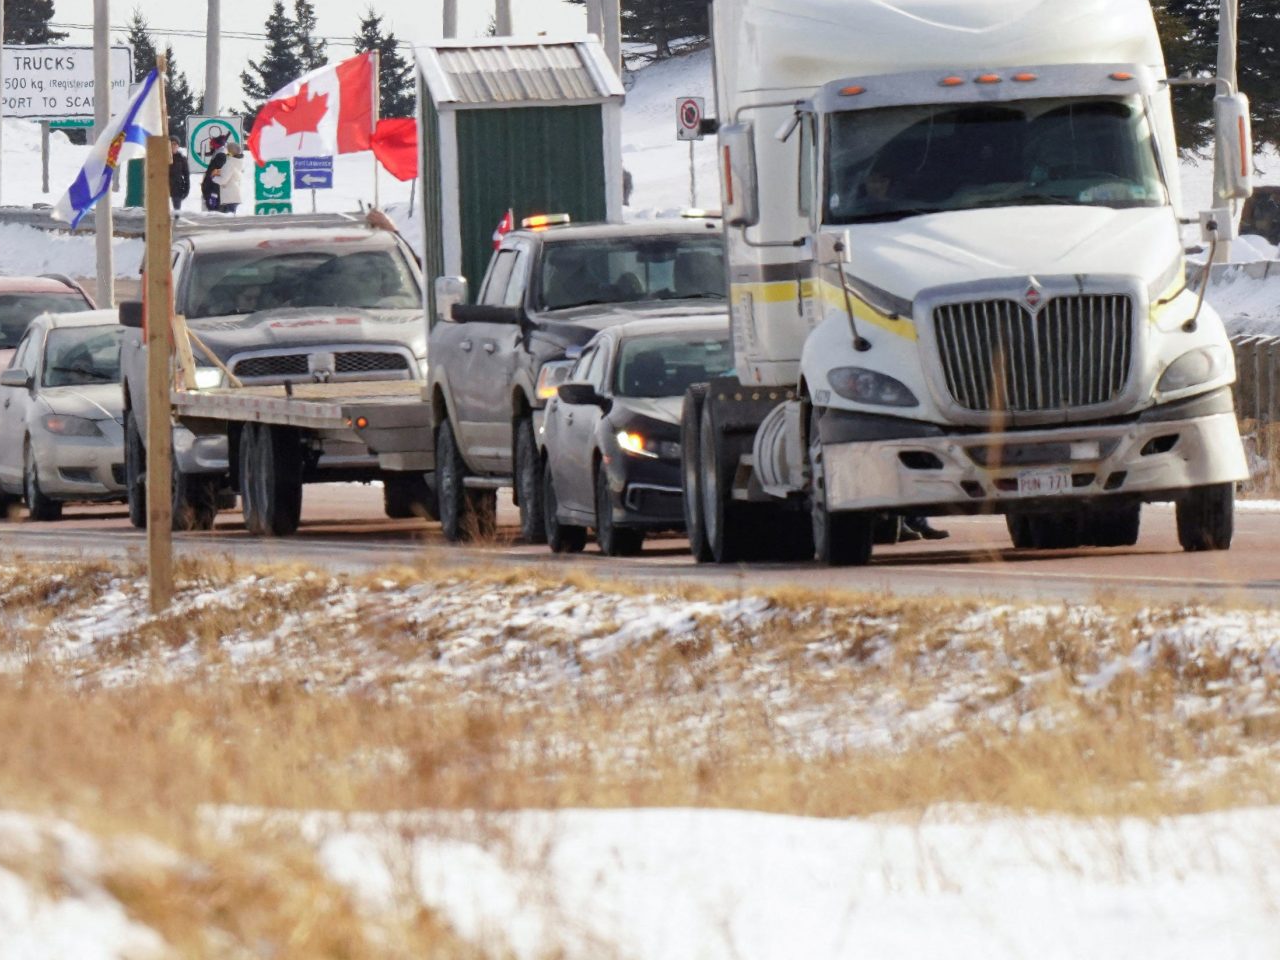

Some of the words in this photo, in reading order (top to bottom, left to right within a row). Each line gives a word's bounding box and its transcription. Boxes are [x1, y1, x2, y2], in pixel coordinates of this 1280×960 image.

[13, 56, 75, 71] TRUCKS
[31, 78, 44, 93] kg
[43, 96, 57, 109] TO
